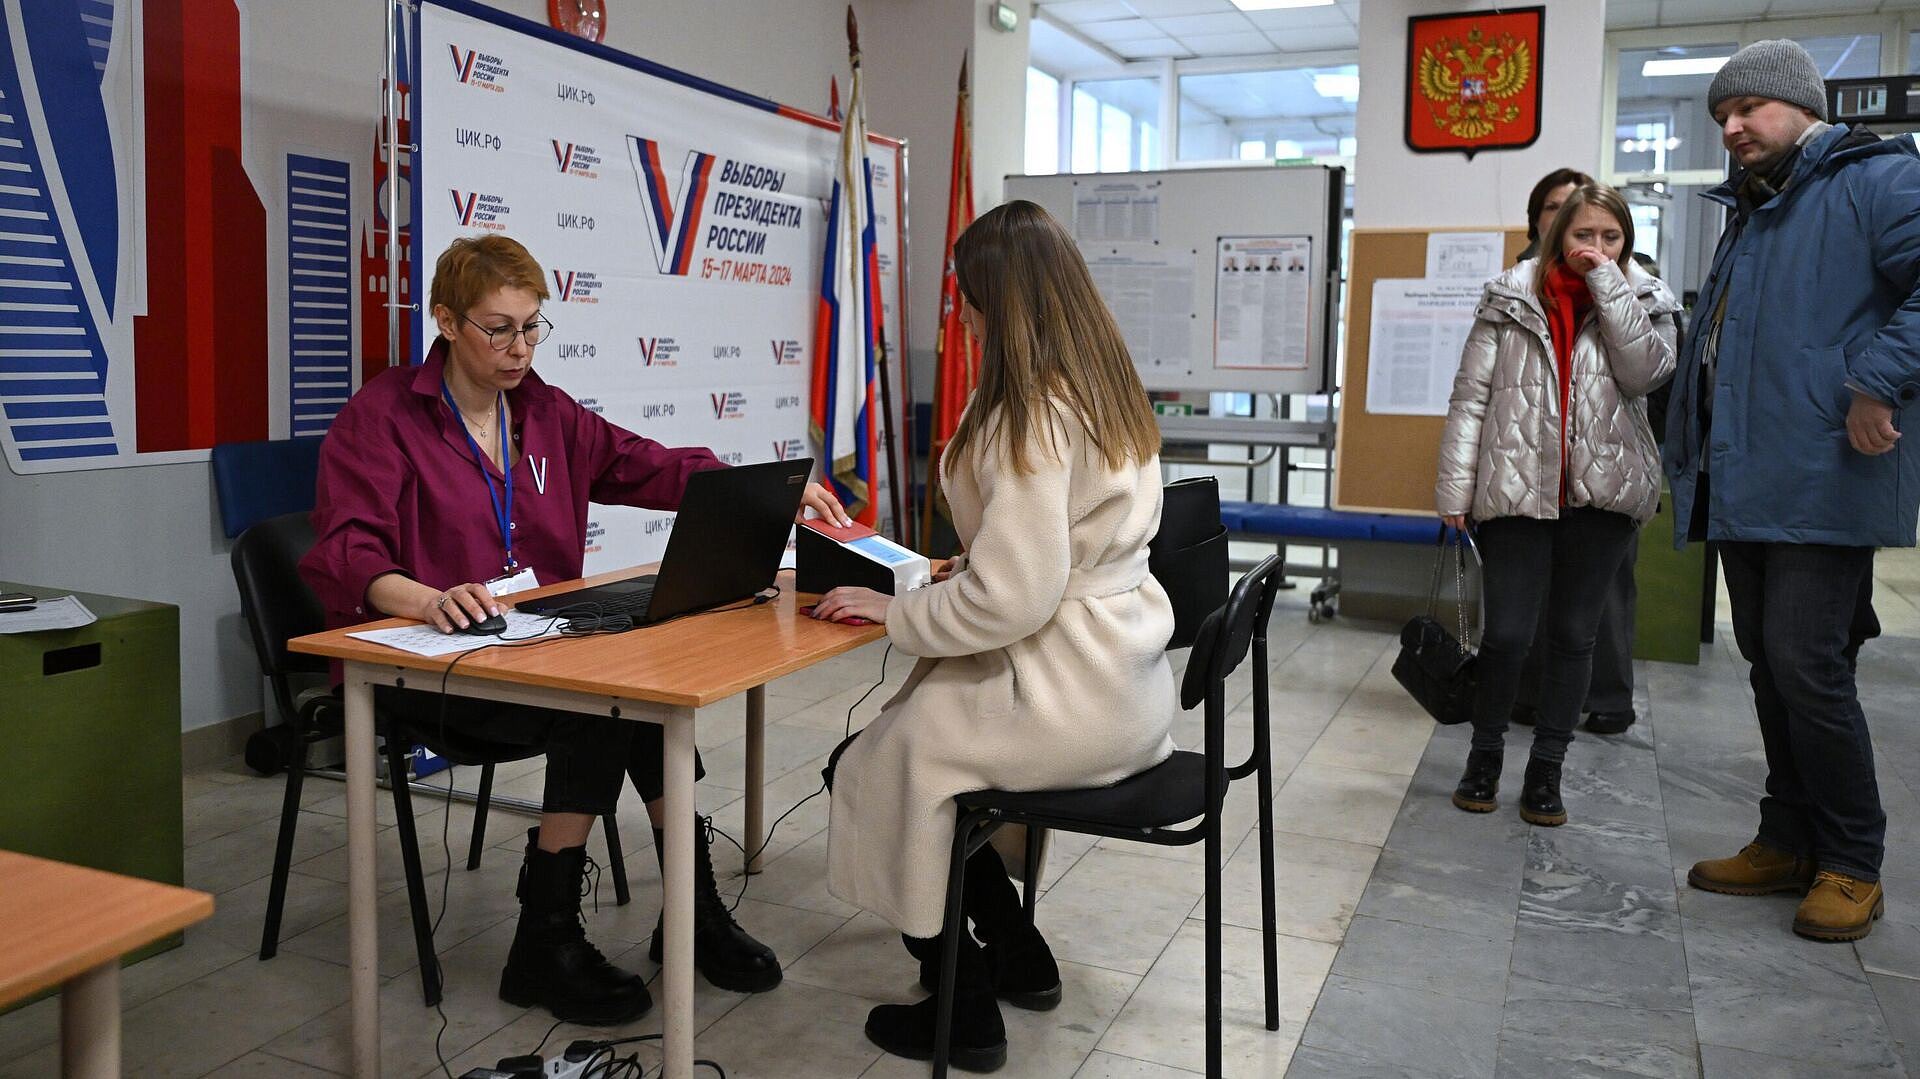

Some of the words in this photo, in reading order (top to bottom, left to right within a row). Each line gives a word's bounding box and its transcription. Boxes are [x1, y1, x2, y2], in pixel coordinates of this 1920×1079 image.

[478, 53, 503, 65] ВЫБОРЫ
[473, 70, 495, 82] РОССИИ
[475, 62, 509, 77] ПРЕЗИДЕНТА
[557, 83, 596, 105] ЦИК.РФ
[456, 128, 502, 151] ЦИК.РФ
[720, 159, 786, 193] ВЫБОРЫ
[479, 194, 503, 204] ВЫБОРЫ
[474, 212, 496, 221] РОССИИ
[477, 203, 510, 214] ПРЕЗИДЕНТА
[714, 192, 802, 229] ПРЕЗИДЕНТА
[557, 212, 595, 231] ЦИК.РФ
[706, 225, 767, 255] РОССИИ
[733, 259, 768, 284] МАРТА
[768, 266, 792, 286] 2024
[558, 344, 597, 360] ЦИК.РФ
[713, 346, 741, 360] ЦИК.РФ
[643, 404, 675, 420] ЦИК.РФ
